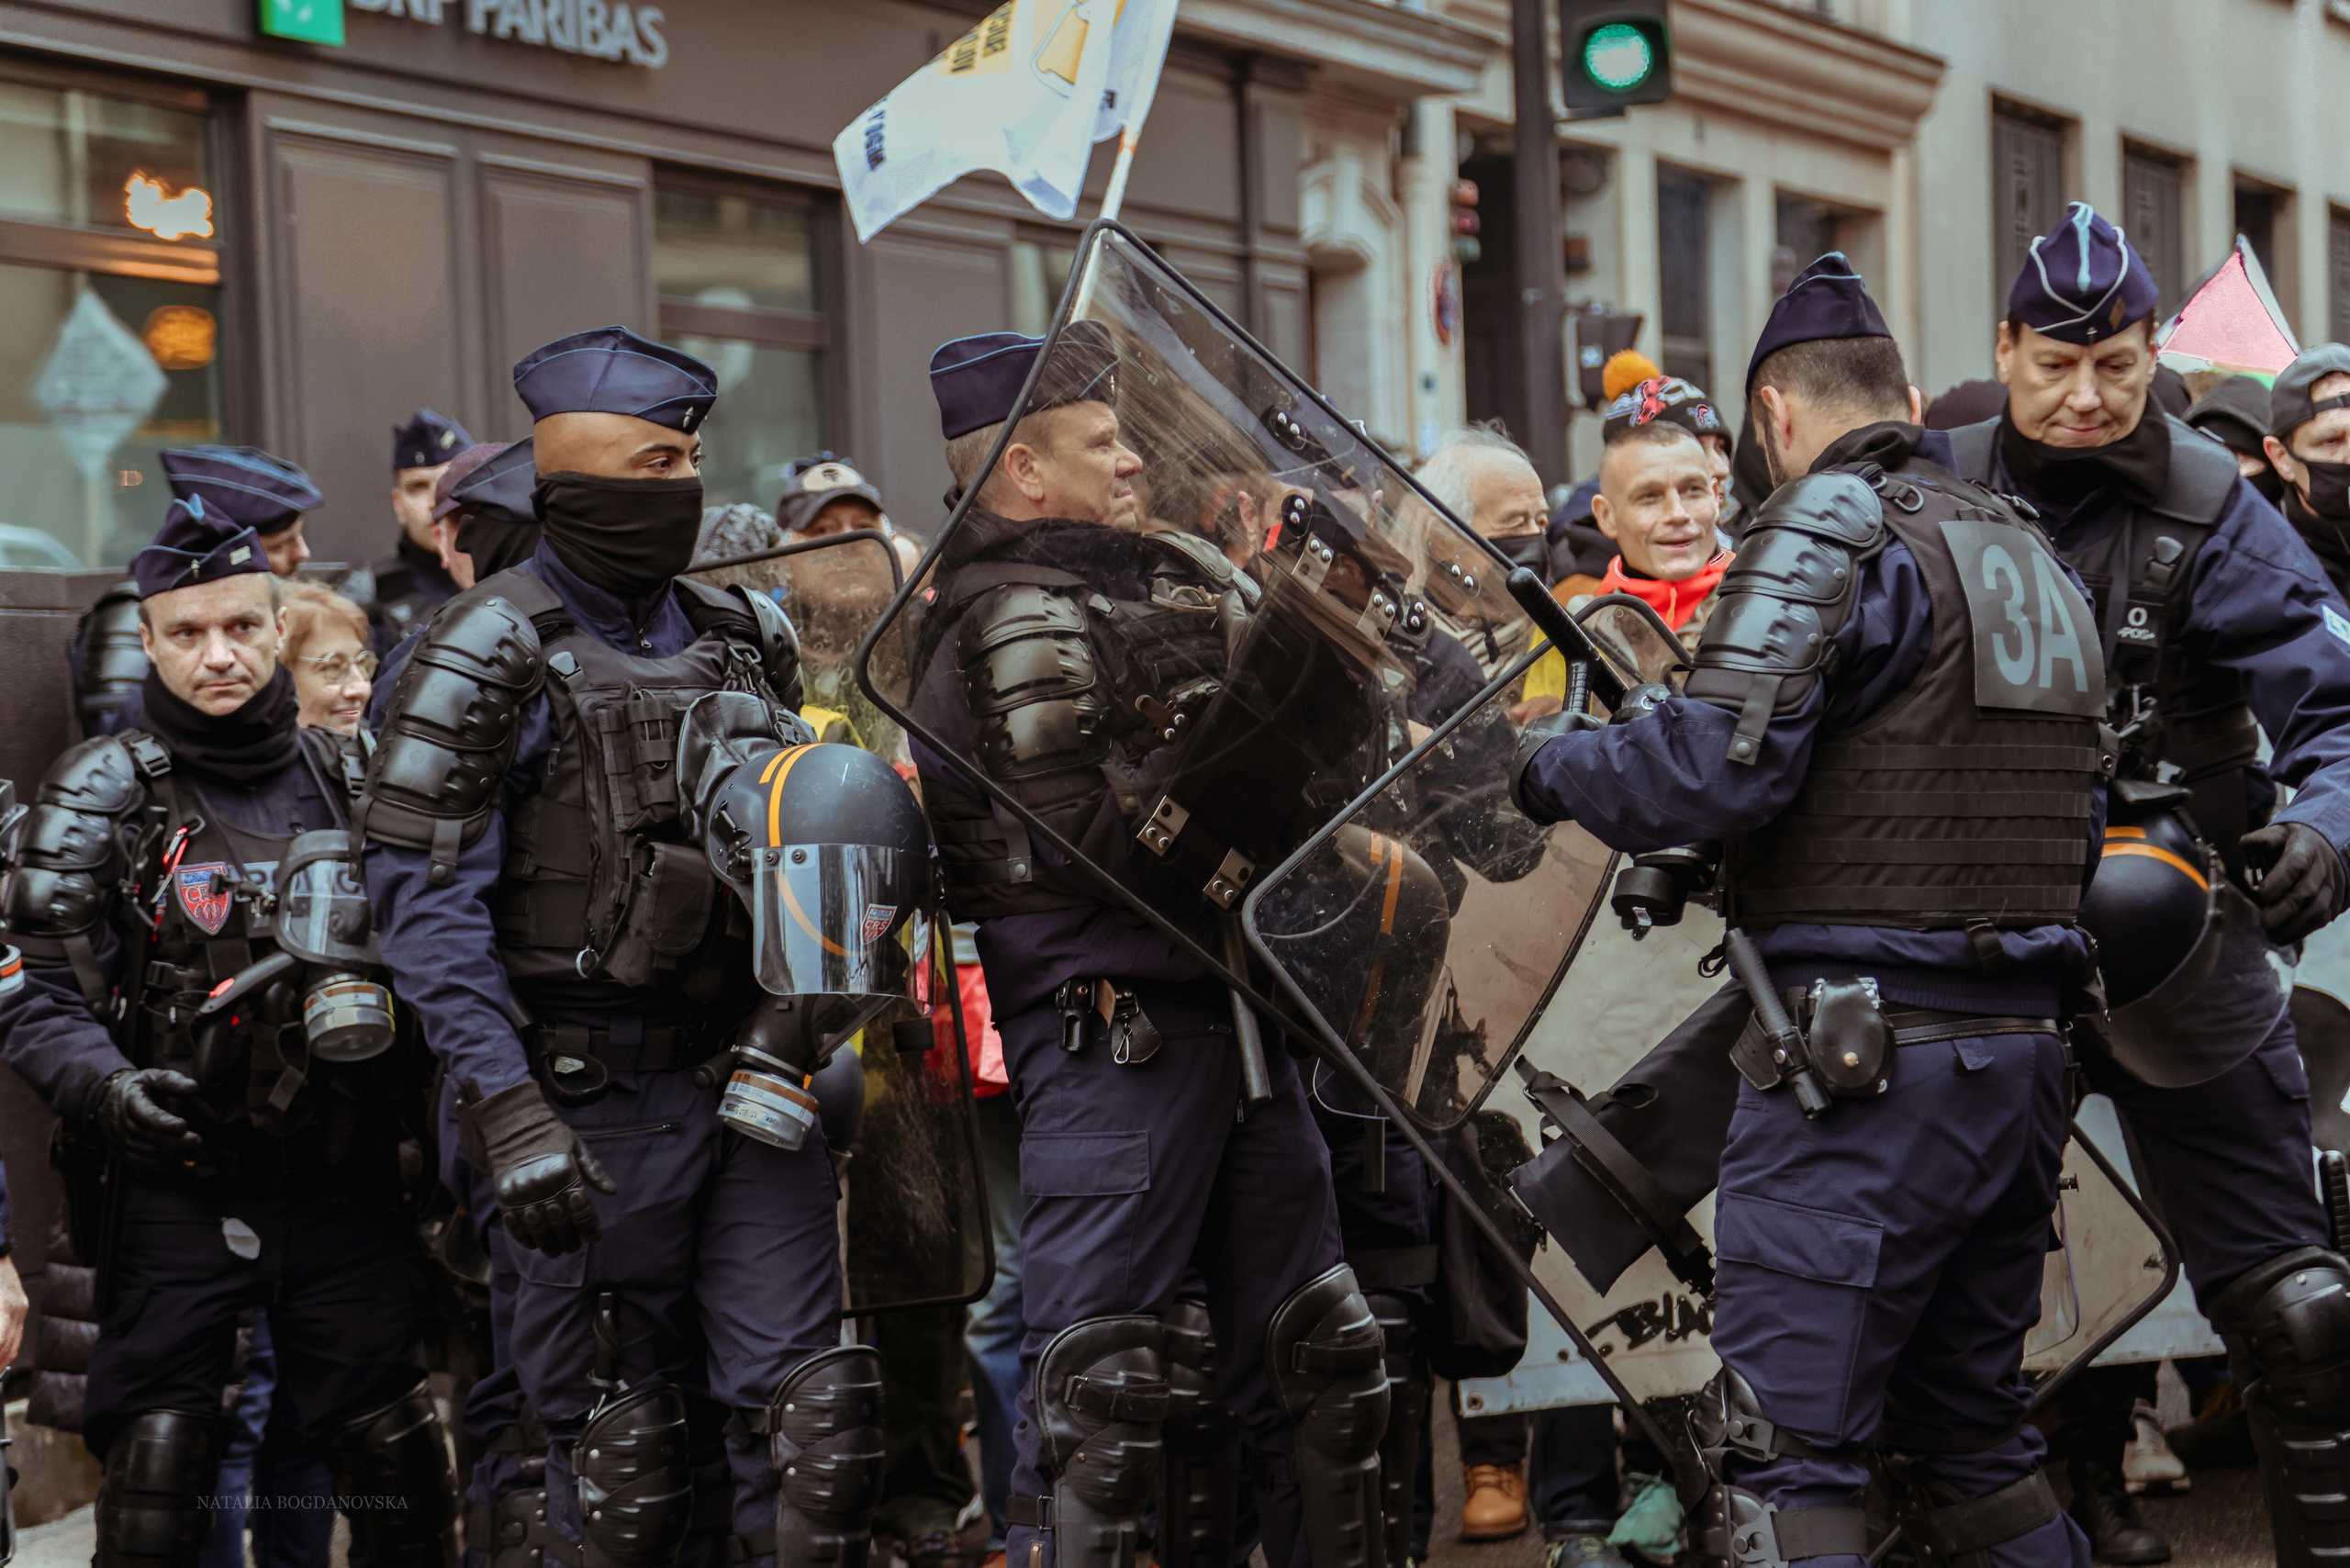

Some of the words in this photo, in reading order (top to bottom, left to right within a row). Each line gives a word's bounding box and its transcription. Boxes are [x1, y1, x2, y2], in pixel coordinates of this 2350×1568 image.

[1982, 544, 2088, 692] 3A
[186, 886, 224, 903] CR
[865, 920, 888, 931] CRS
